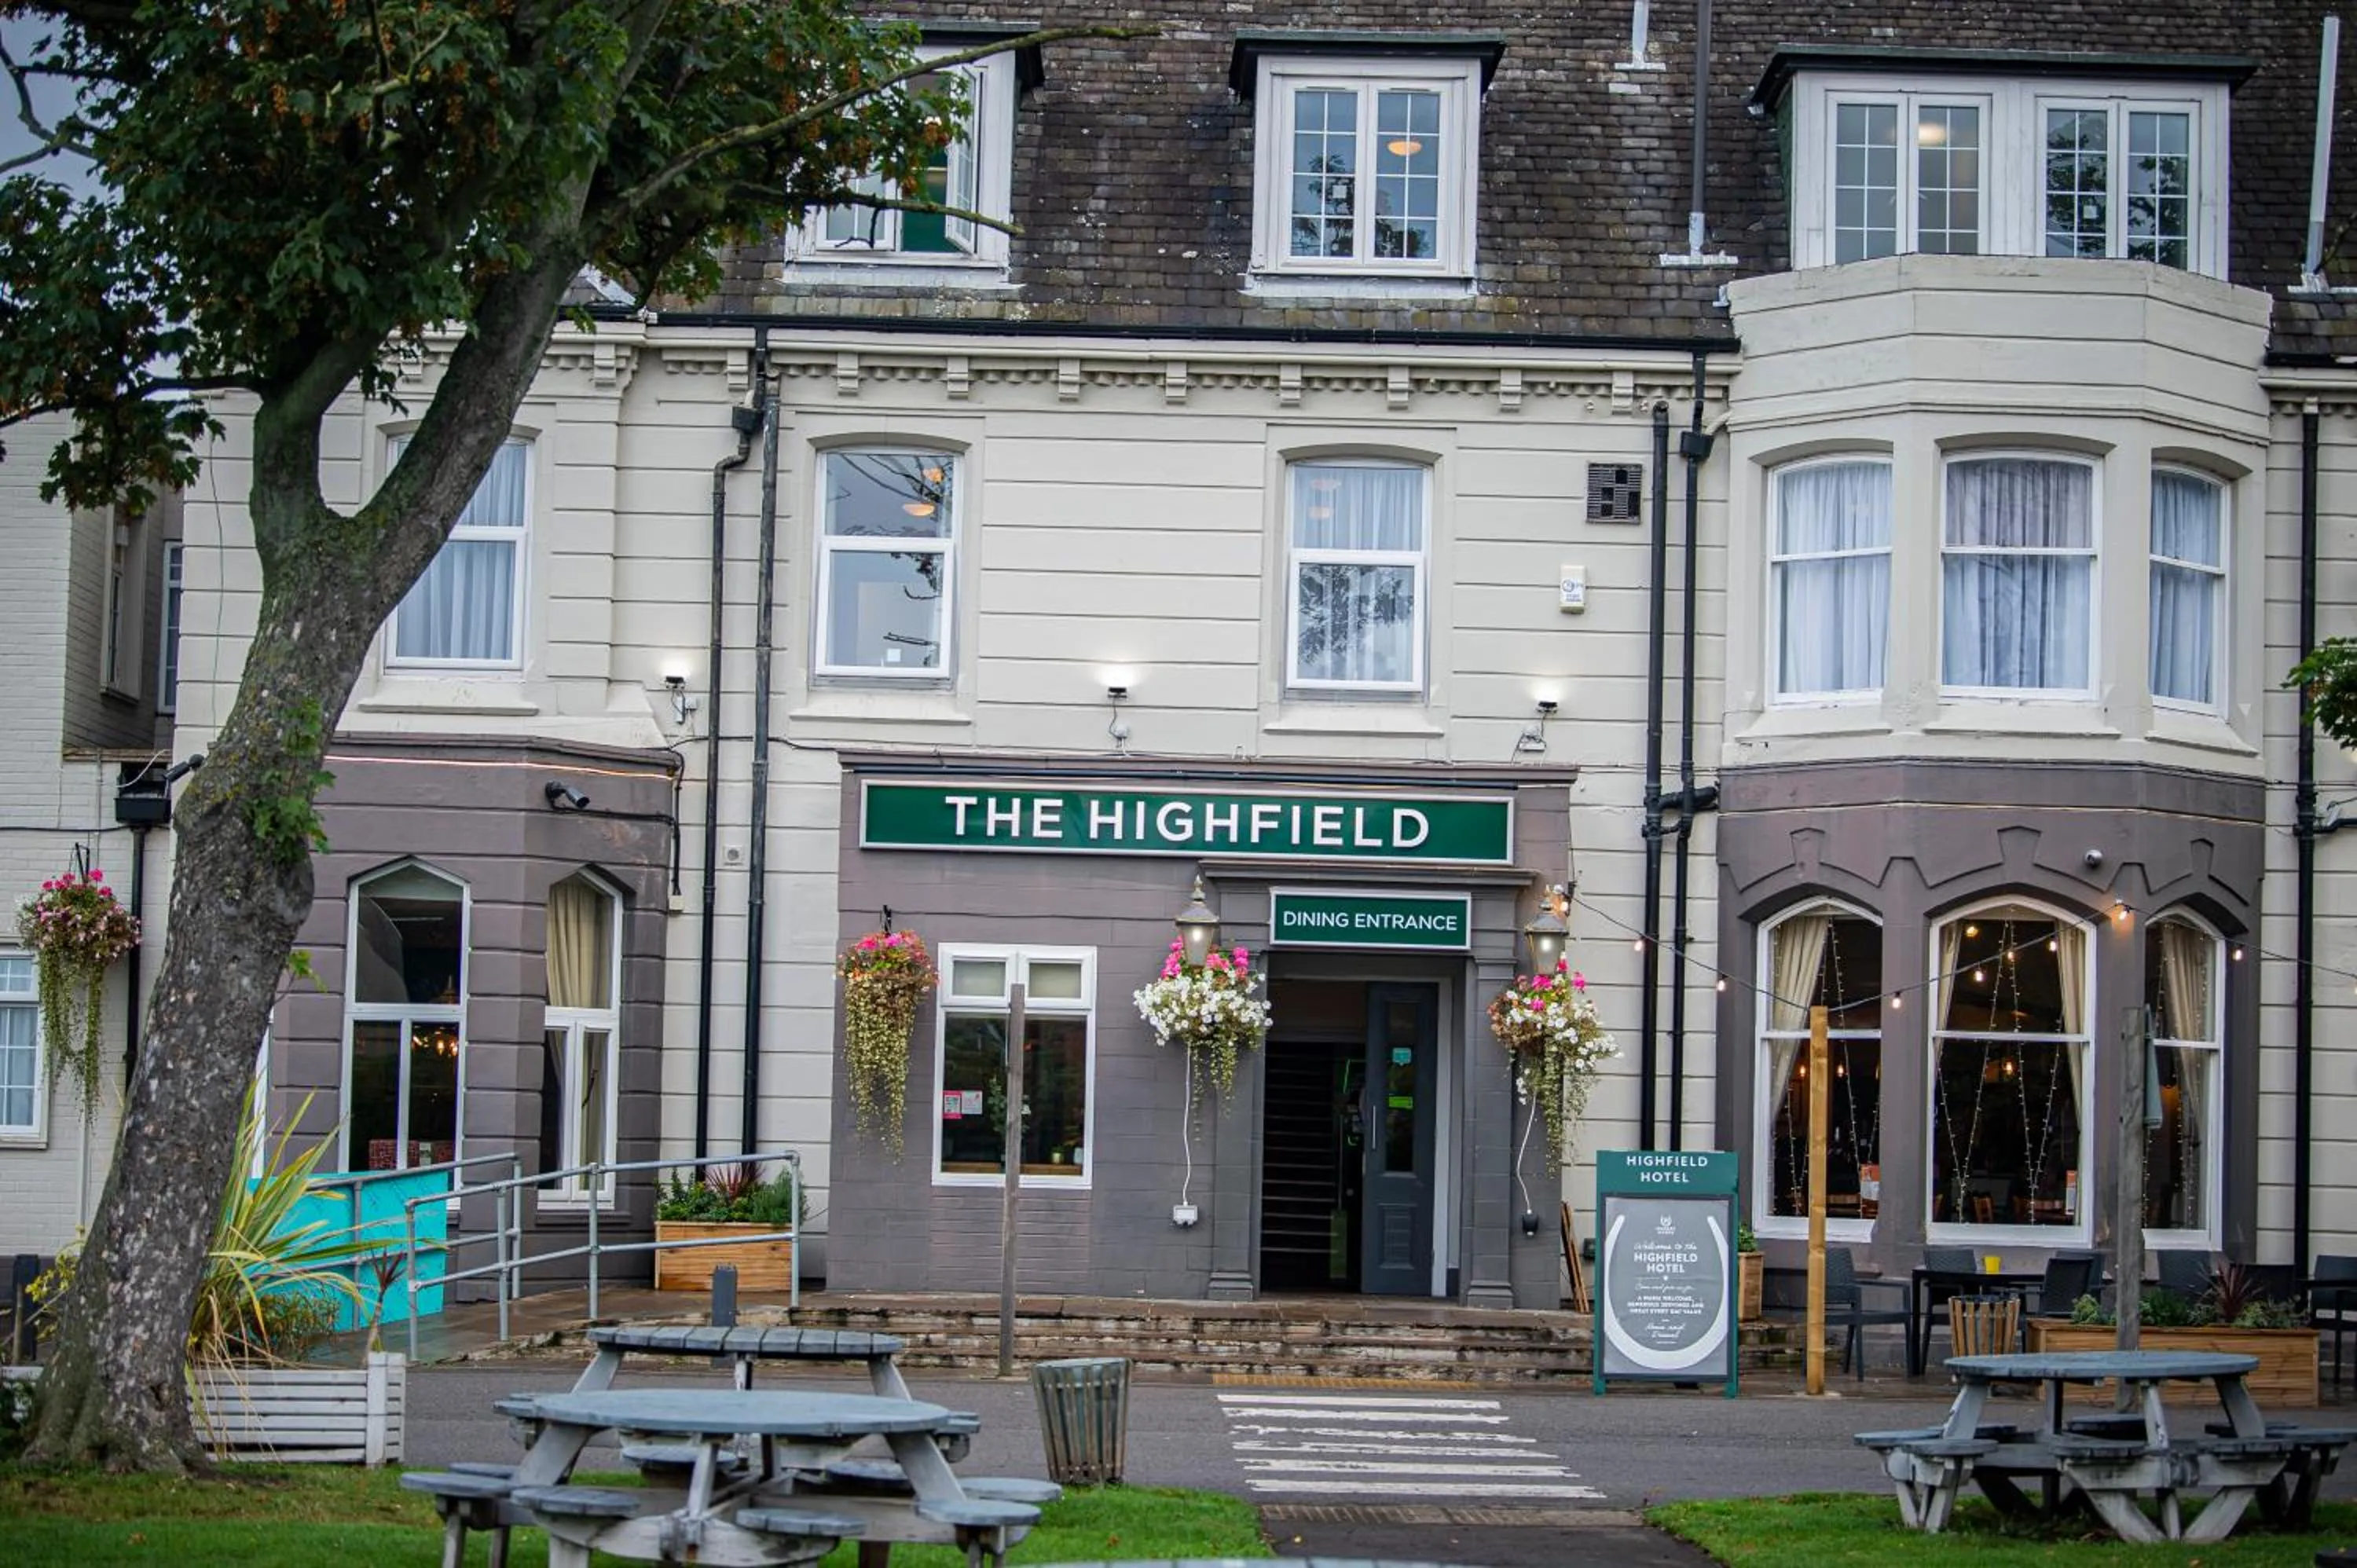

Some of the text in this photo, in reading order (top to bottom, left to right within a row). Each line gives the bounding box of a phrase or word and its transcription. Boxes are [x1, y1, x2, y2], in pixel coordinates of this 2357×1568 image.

[945, 795, 1429, 848] THE HIGHFIELD
[1282, 910, 1458, 932] DINING ENTRANCE
[1626, 1156, 1708, 1167] HIGHFIELD
[1640, 1171, 1689, 1182] HOTEL
[1634, 1252, 1698, 1262] HIGHFIELD
[1646, 1262, 1684, 1273] HOTEL
